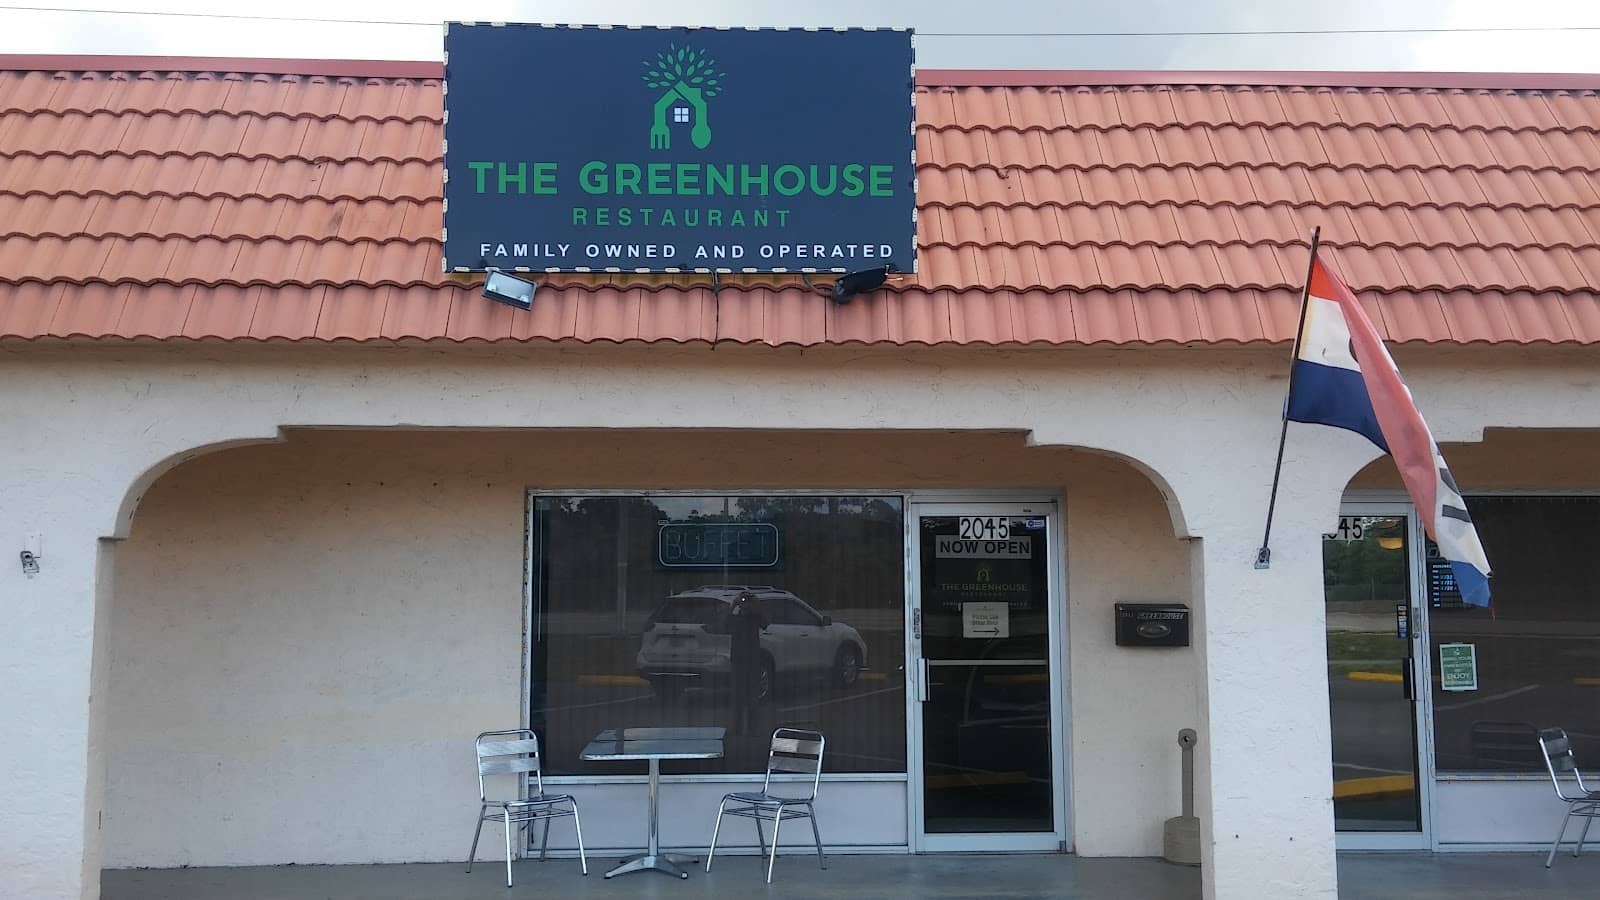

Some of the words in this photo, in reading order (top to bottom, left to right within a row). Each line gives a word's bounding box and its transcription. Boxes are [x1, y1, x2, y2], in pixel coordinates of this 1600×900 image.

[468, 161, 558, 194] THE
[579, 160, 895, 197] GREENHOUSE
[572, 207, 791, 227] RESTAURANT
[480, 243, 570, 258] FAMILY
[585, 244, 677, 259] OWNED
[695, 244, 745, 259] AND
[759, 244, 894, 259] OPERATED
[960, 517, 1009, 540] 2045
[1322, 517, 1363, 539] 45
[665, 529, 769, 560] BUFFET
[940, 540, 978, 554] NOW
[984, 540, 1030, 554] OPEN
[942, 583, 961, 592] THE
[962, 583, 1028, 592] GREENHOUSE
